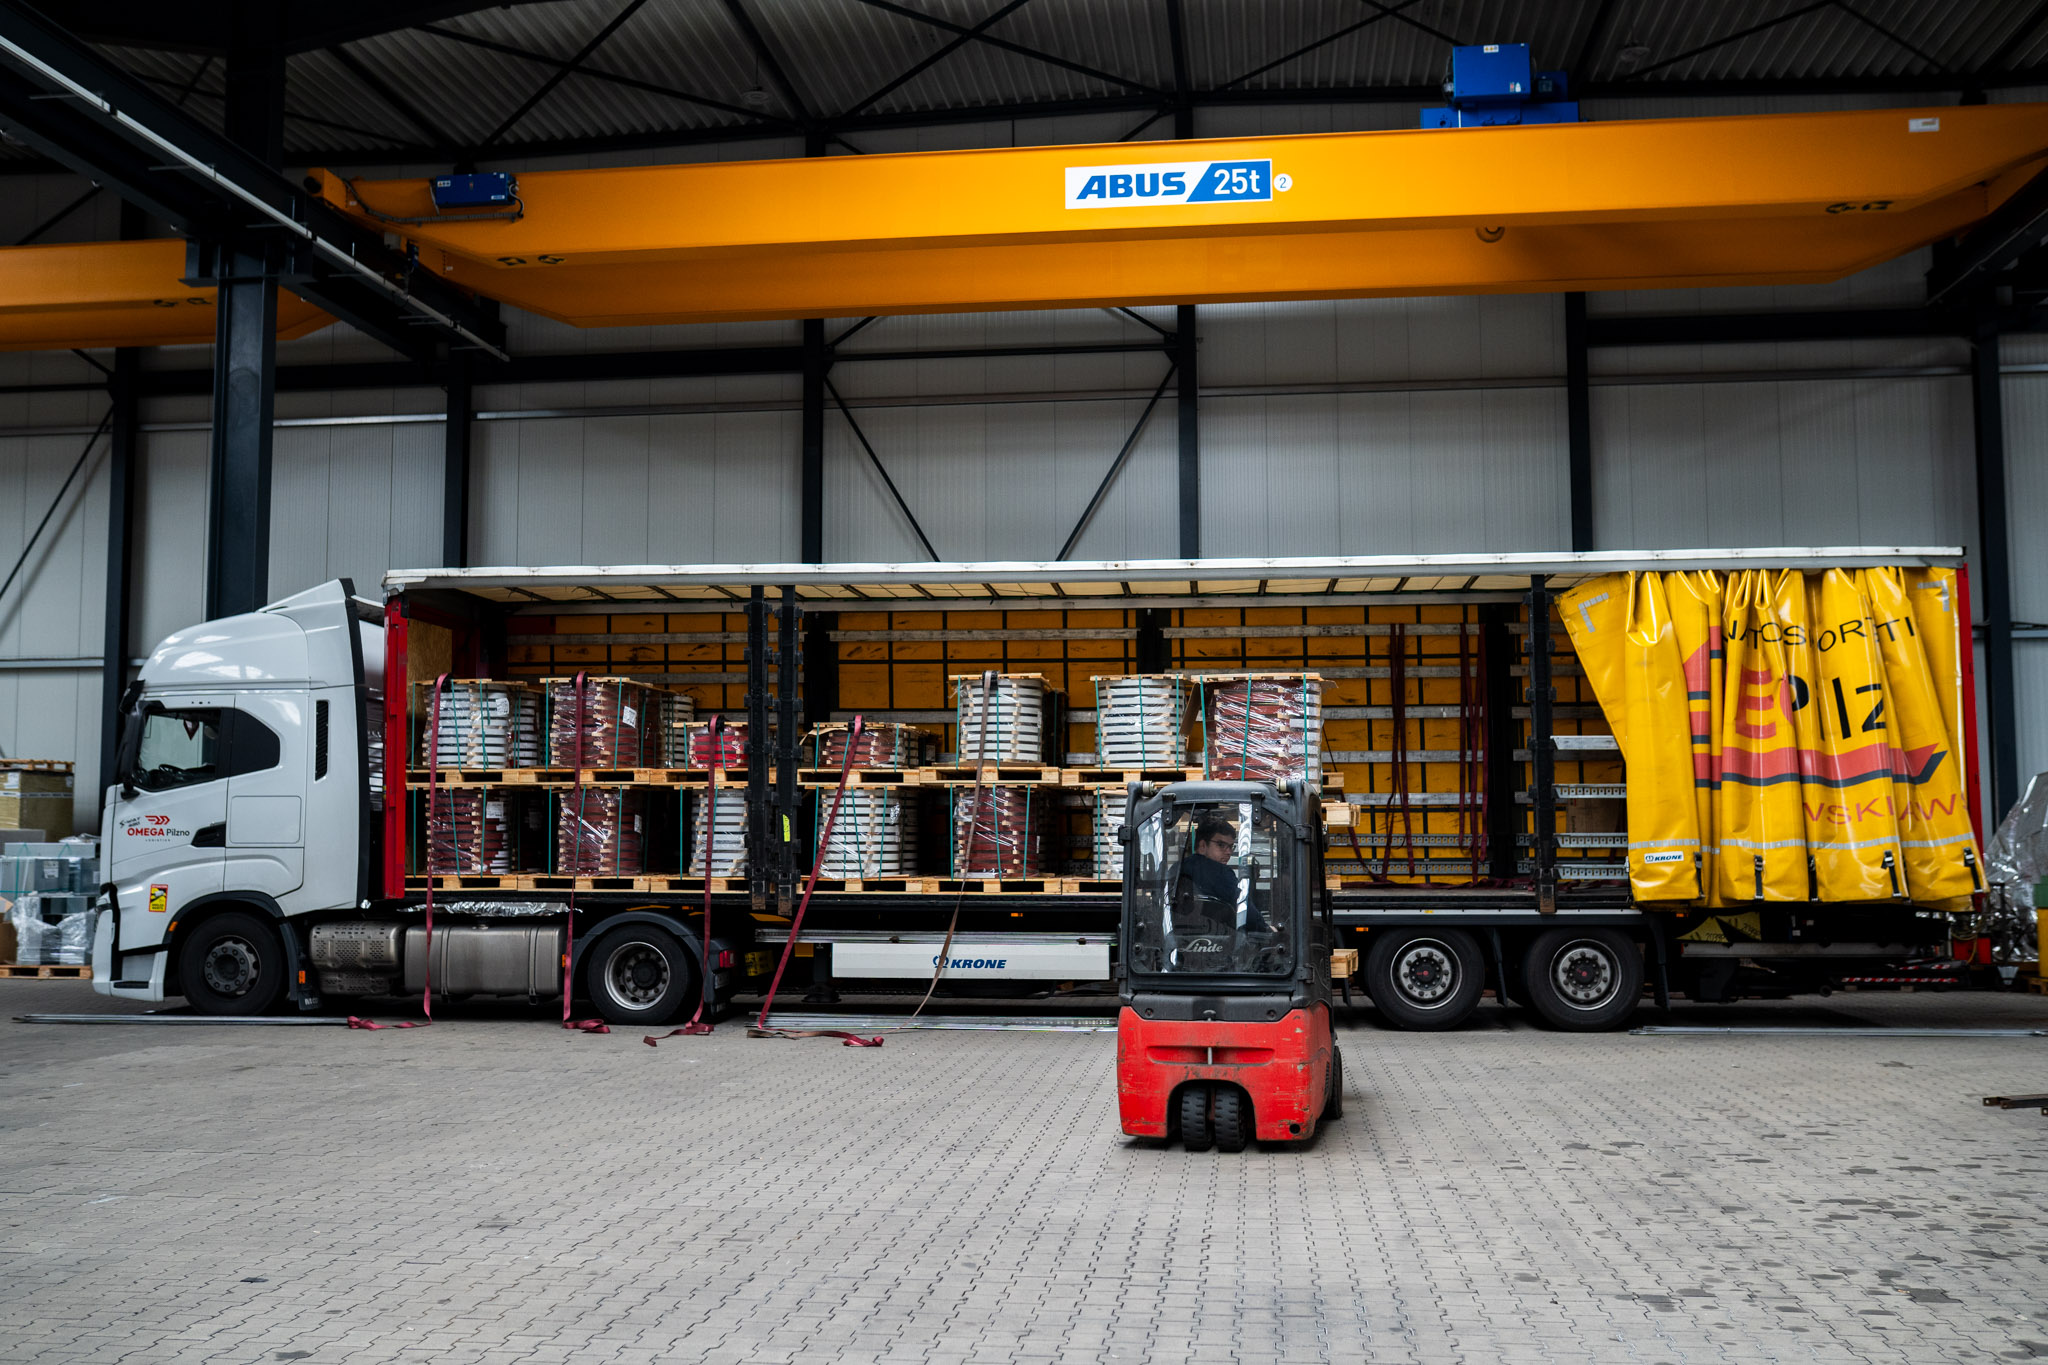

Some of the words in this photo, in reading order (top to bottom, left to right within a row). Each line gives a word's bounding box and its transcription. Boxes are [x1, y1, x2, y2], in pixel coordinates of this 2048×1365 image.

[1076, 171, 1186, 200] ABUS
[1213, 168, 1261, 195] 25t
[1279, 176, 1287, 189] 2
[127, 827, 165, 836] OMEGA
[166, 828, 190, 836] Pilzno
[1654, 854, 1683, 862] KRONE
[1178, 937, 1223, 953] Linde
[950, 958, 1007, 969] KRONE
